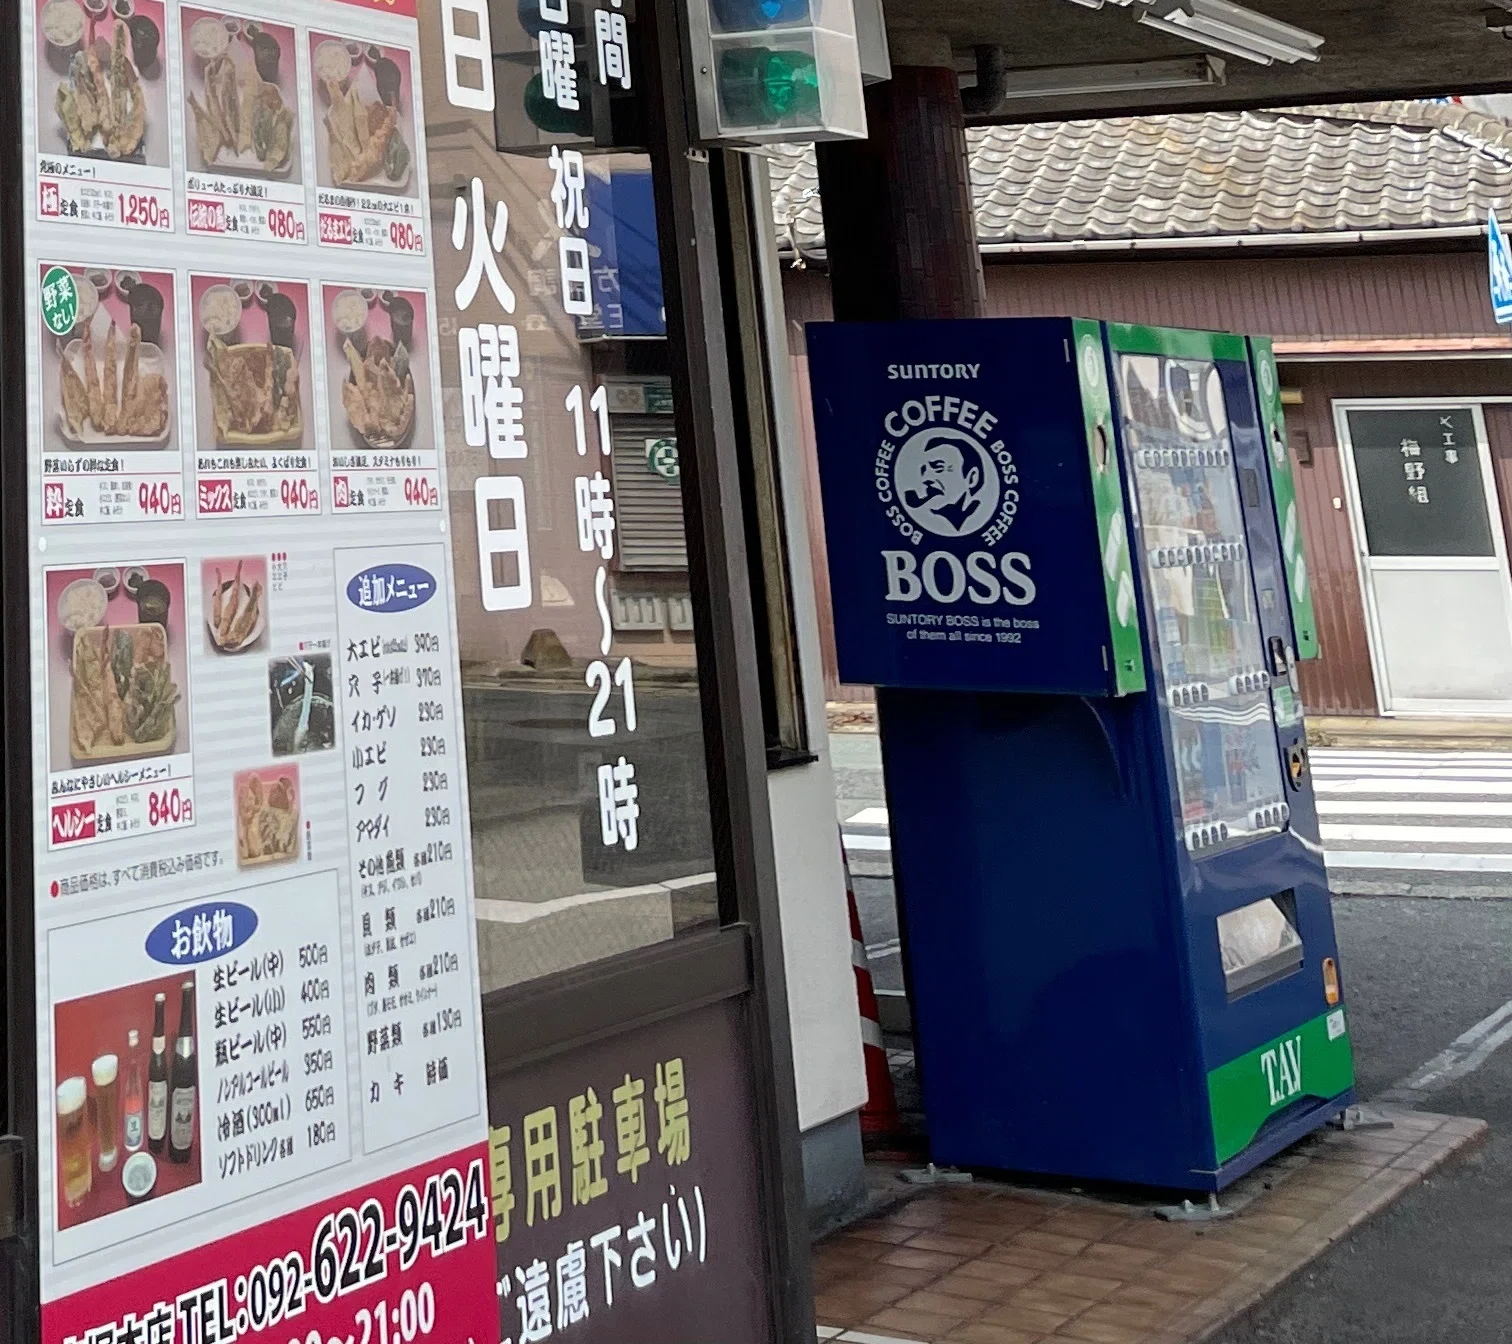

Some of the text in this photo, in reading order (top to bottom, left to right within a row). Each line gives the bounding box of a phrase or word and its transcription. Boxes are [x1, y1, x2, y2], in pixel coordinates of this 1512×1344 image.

[118, 193, 170, 228] 1,250円
[268, 209, 305, 240] 980円
[390, 221, 423, 252] 980円
[548, 144, 593, 315] 祝日
[43, 275, 73, 312] 野菜
[52, 303, 75, 330] なし!
[888, 363, 980, 380] SUNTORY
[451, 177, 532, 612] 火曜日
[884, 395, 999, 440] COFFEE
[139, 482, 182, 515] 940円
[281, 478, 319, 510] 940円
[404, 477, 438, 506] 940円
[875, 439, 924, 545] BOSS COFFEE
[981, 439, 1020, 547] BOSS COFFEE
[358, 574, 429, 606] 追加メニュー
[881, 550, 1037, 605] BOSS
[886, 613, 1039, 629] SUNTORY BOSS is the boss
[906, 629, 917, 640] of
[919, 630, 946, 640] them
[949, 631, 962, 641] all
[964, 632, 992, 642] since
[346, 635, 381, 661] 大エビ
[352, 740, 387, 770] 小エビ
[148, 788, 193, 826] 840円
[170, 909, 233, 959] お飲物
[213, 949, 284, 992] 生ビール(中)
[298, 943, 328, 968] 500円
[214, 985, 285, 1029] 生ビール(小)
[300, 978, 330, 1003] 400円
[302, 1013, 331, 1040] 550円
[304, 1048, 333, 1075] 350円
[305, 1084, 335, 1112] 650円
[307, 1120, 336, 1149] 180円
